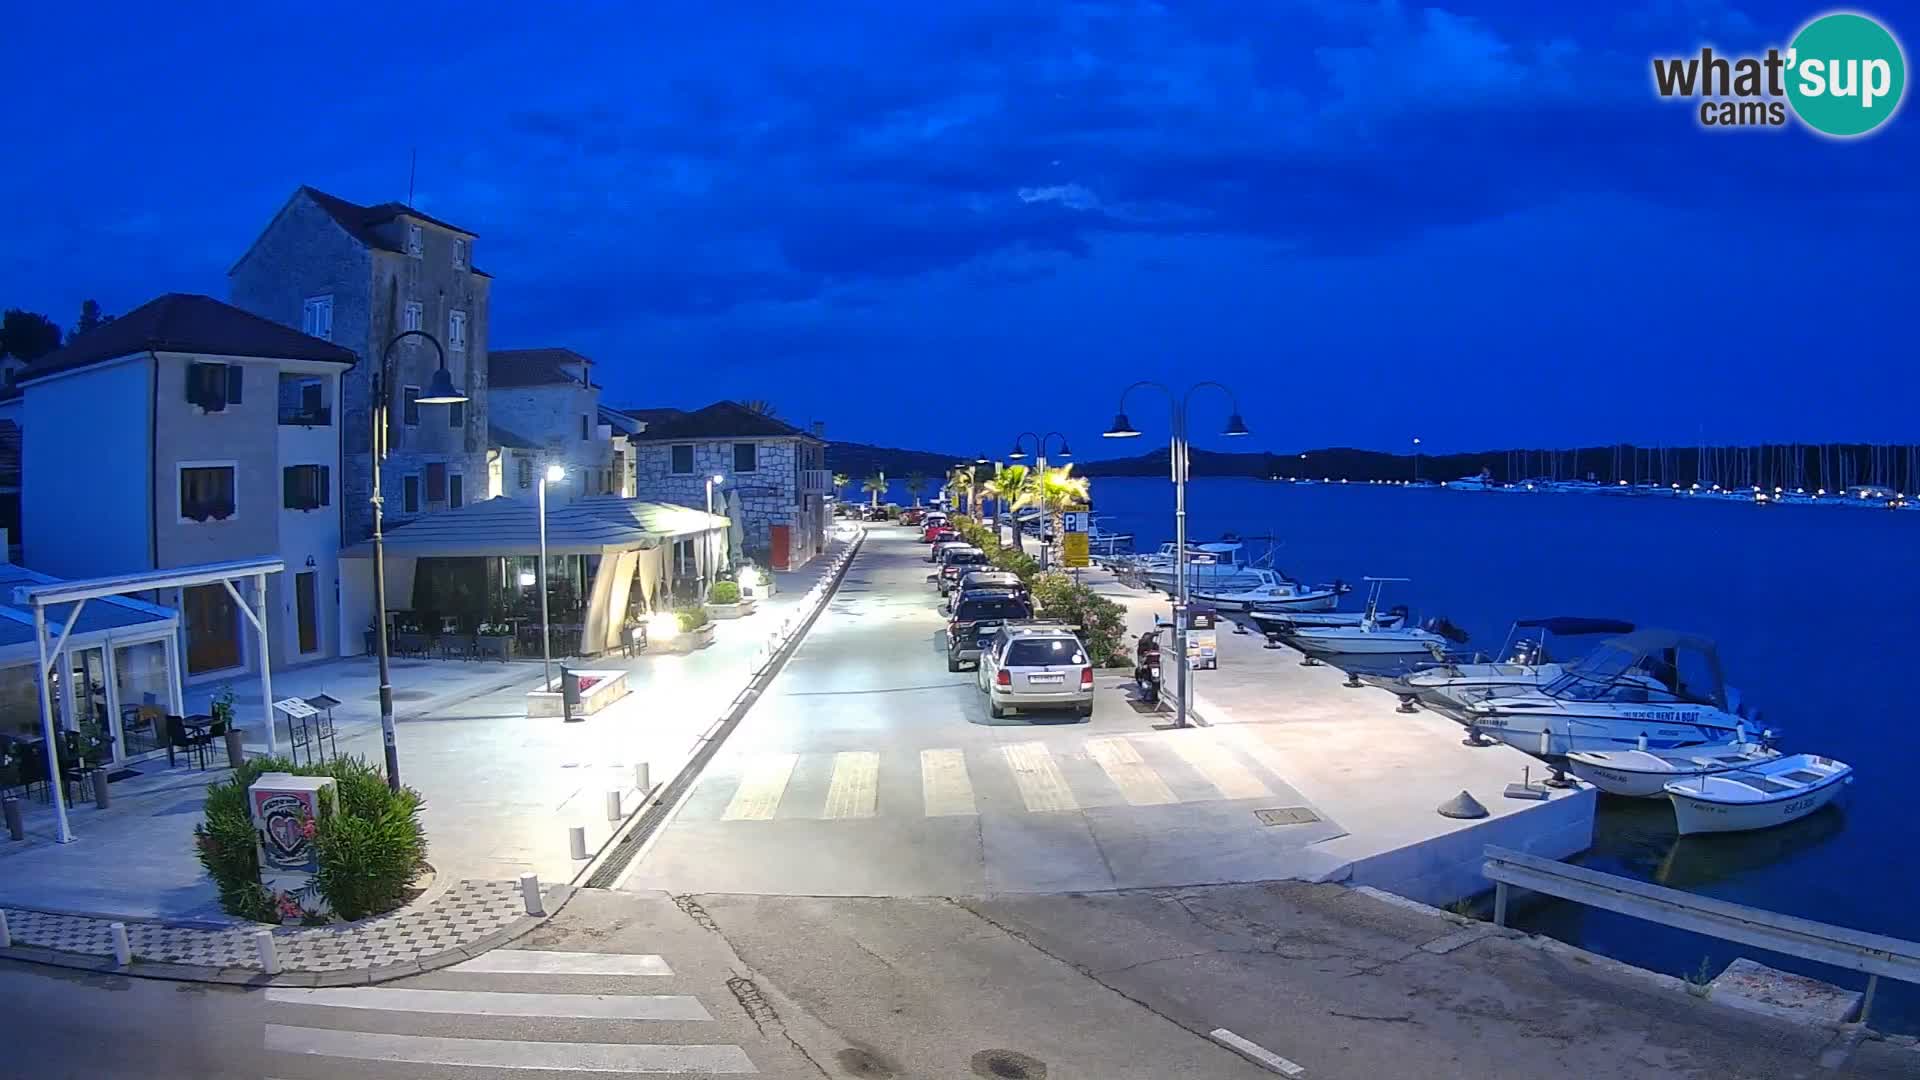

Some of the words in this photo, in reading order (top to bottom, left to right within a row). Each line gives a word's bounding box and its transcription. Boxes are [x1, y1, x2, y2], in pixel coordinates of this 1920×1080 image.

[1066, 514, 1076, 530] P
[1655, 711, 1674, 721] RENT
[1681, 711, 1700, 722] BOAT
